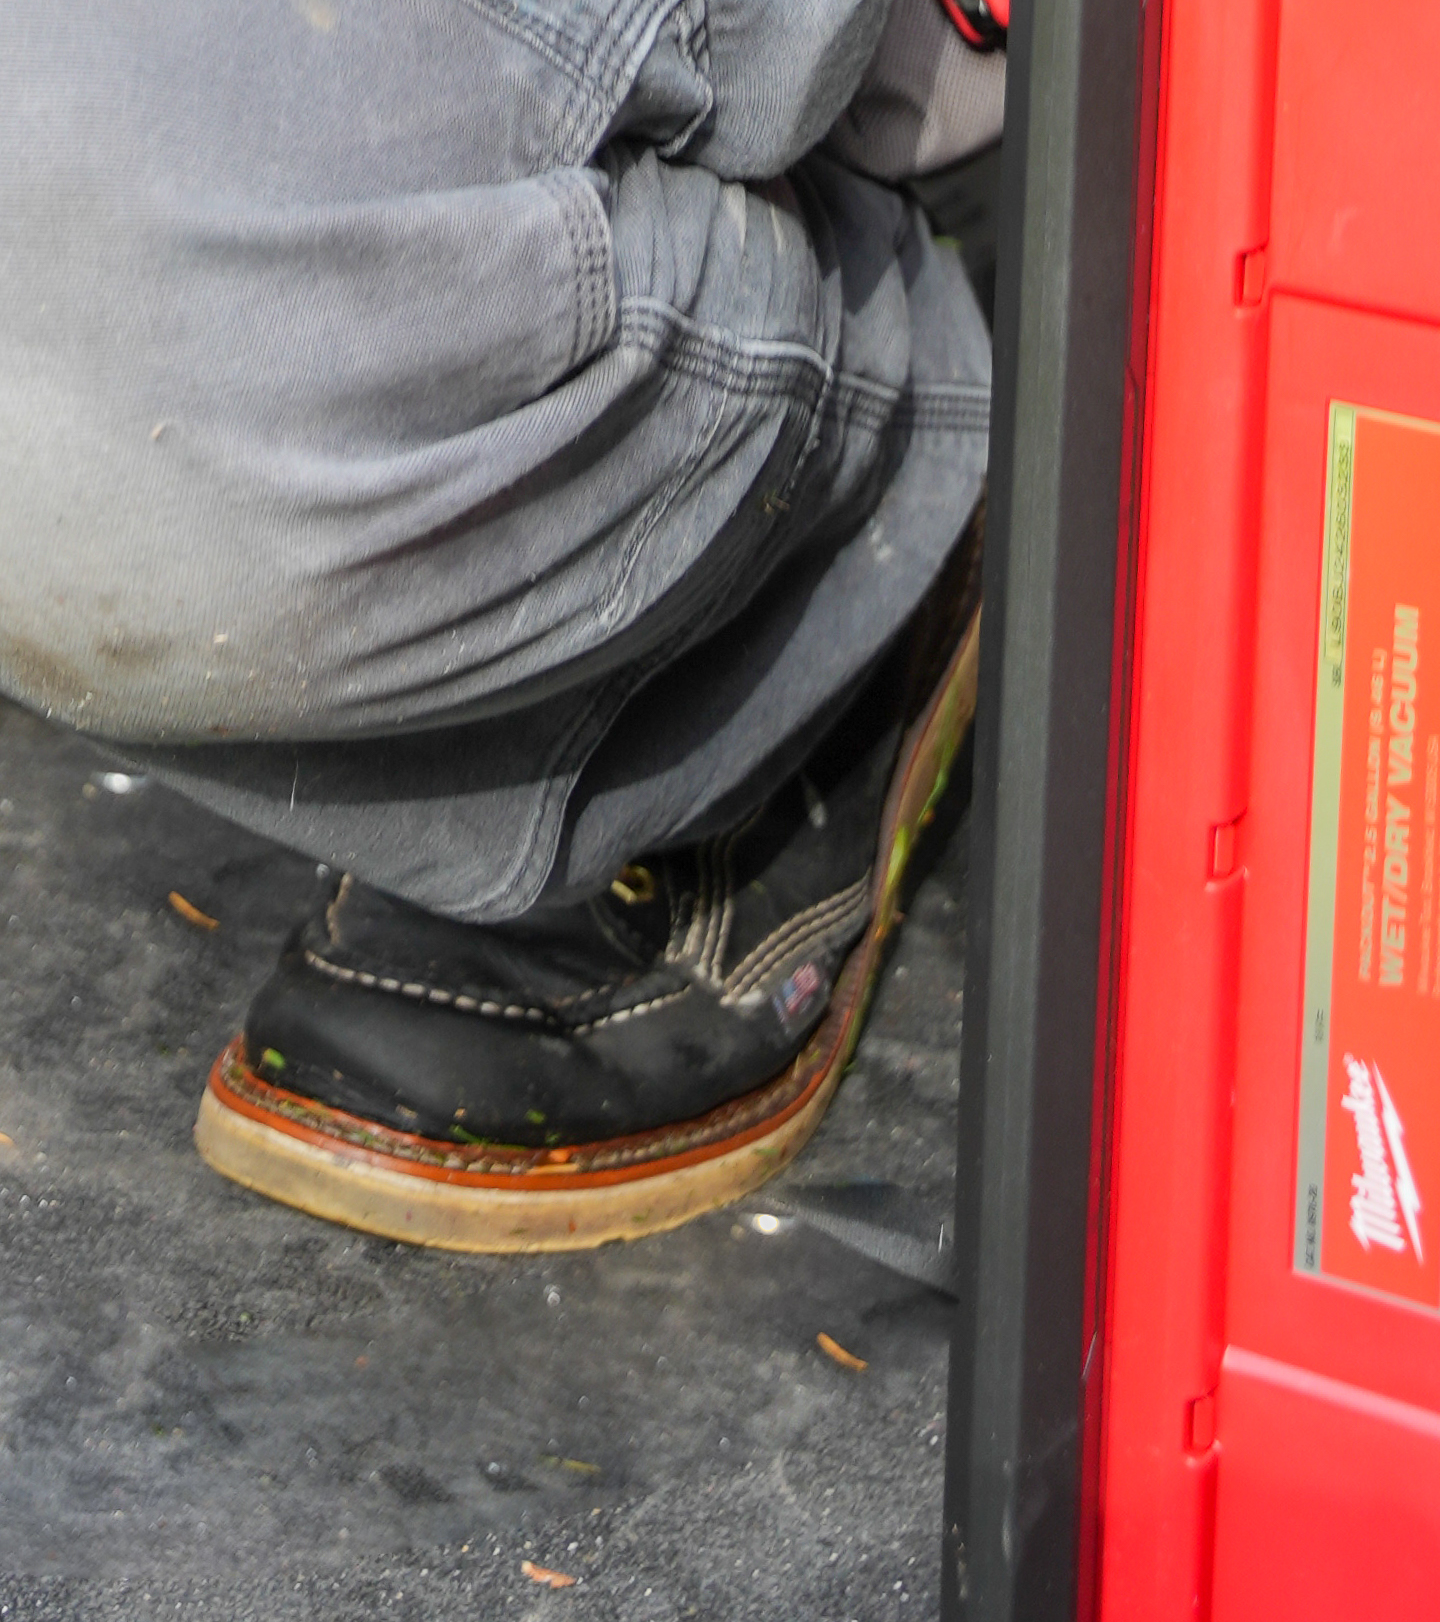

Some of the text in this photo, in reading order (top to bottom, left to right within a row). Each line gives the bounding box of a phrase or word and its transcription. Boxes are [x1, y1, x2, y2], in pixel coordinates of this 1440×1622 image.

[1378, 602, 1420, 984] WET/DRY VACUUM
[1341, 1052, 1407, 1252] Milwaukee
